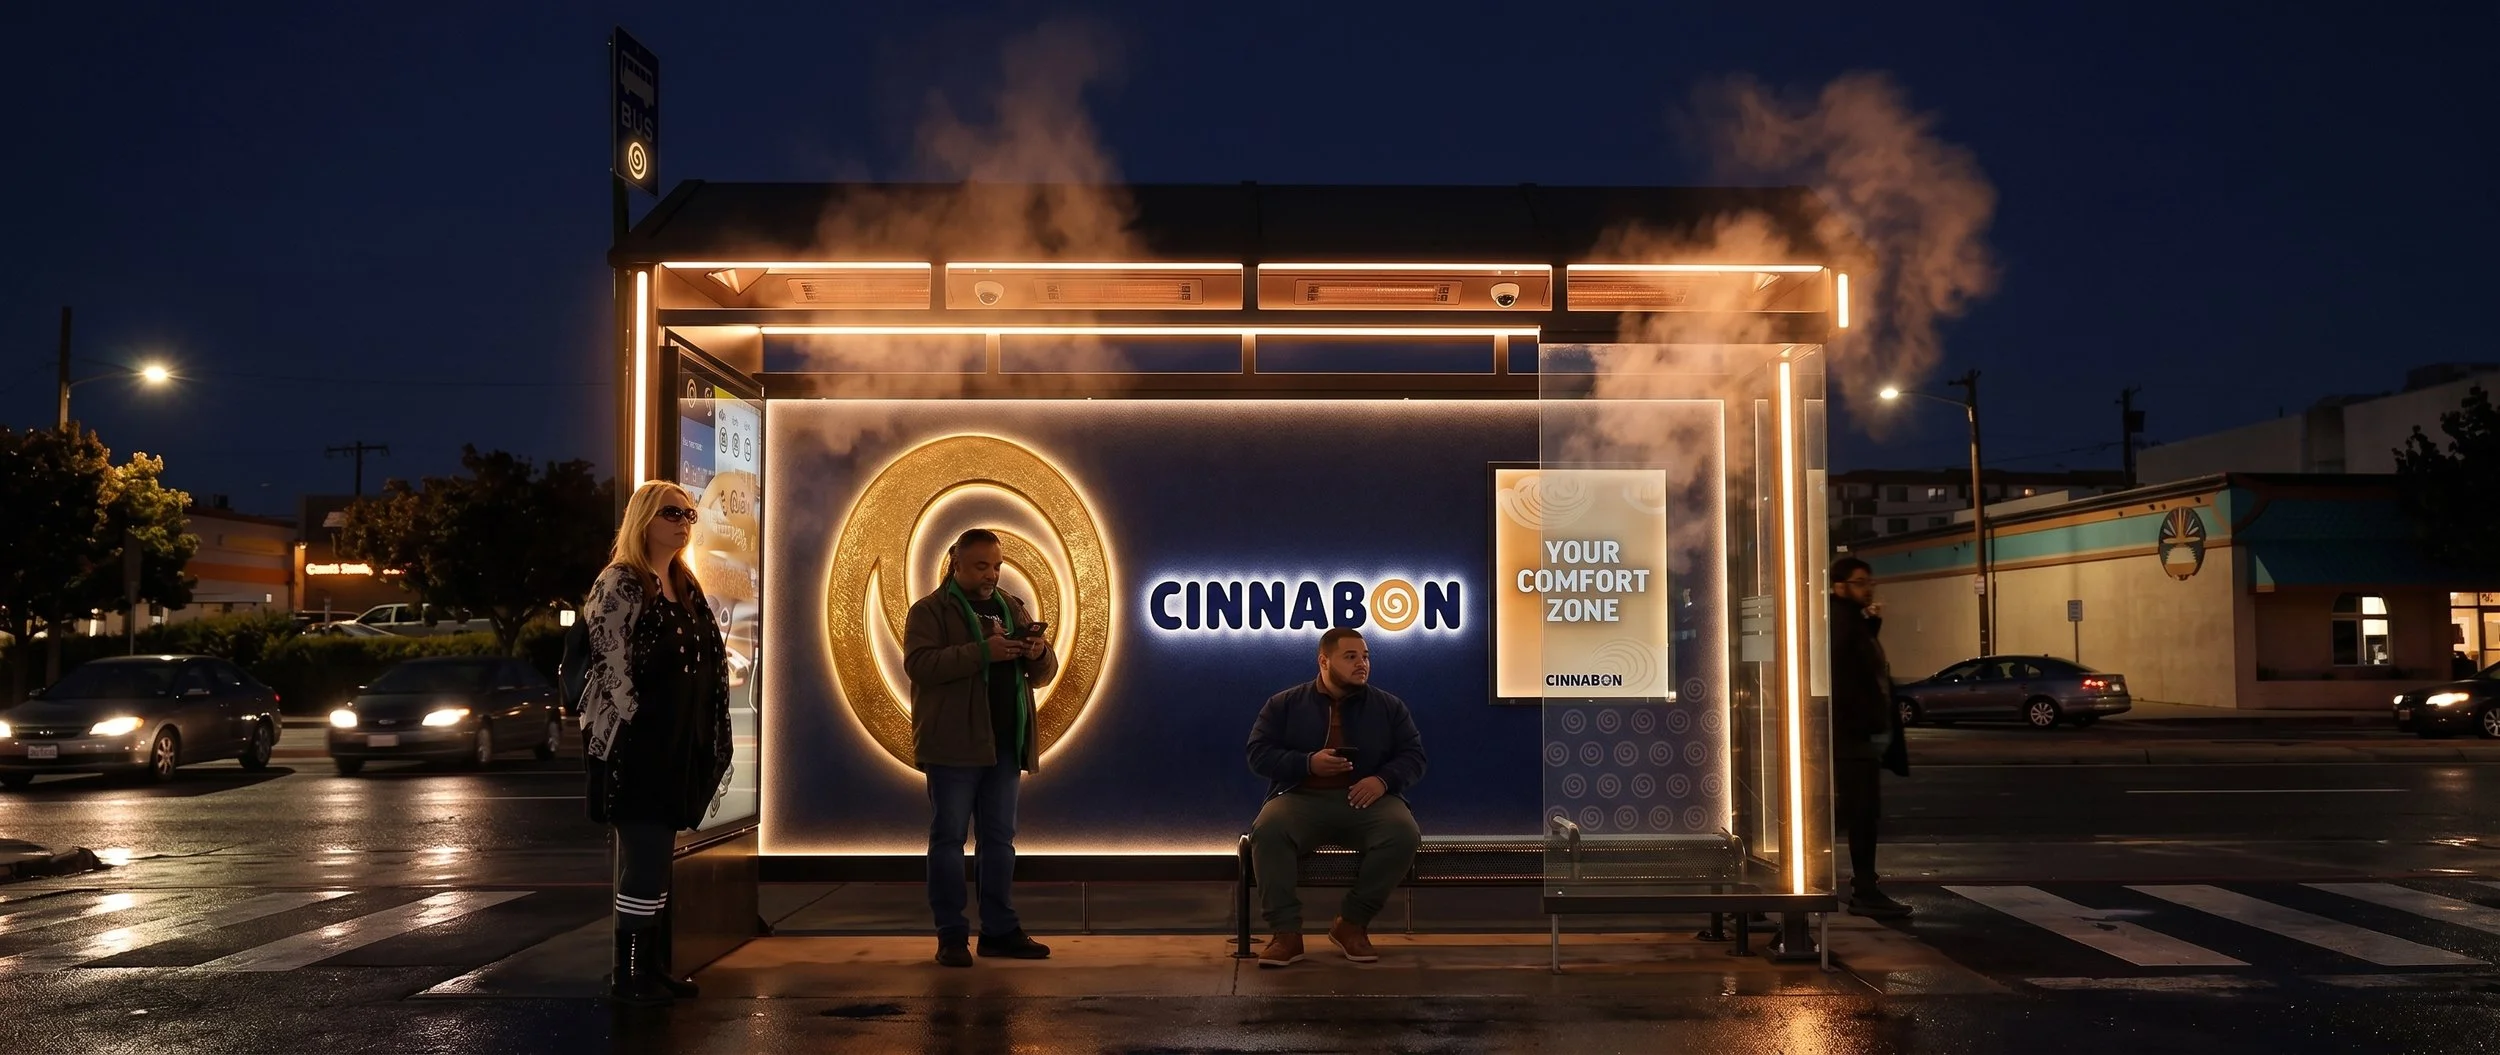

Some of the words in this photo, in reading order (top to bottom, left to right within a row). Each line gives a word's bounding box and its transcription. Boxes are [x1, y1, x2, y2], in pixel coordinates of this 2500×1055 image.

[621, 101, 653, 143] BUS
[1545, 540, 1620, 564] YOUR
[1517, 569, 1650, 593] COMFORT
[1150, 579, 1461, 632] CINNABON
[1546, 598, 1619, 622] ZONE
[1545, 674, 1622, 687] CINNABON
